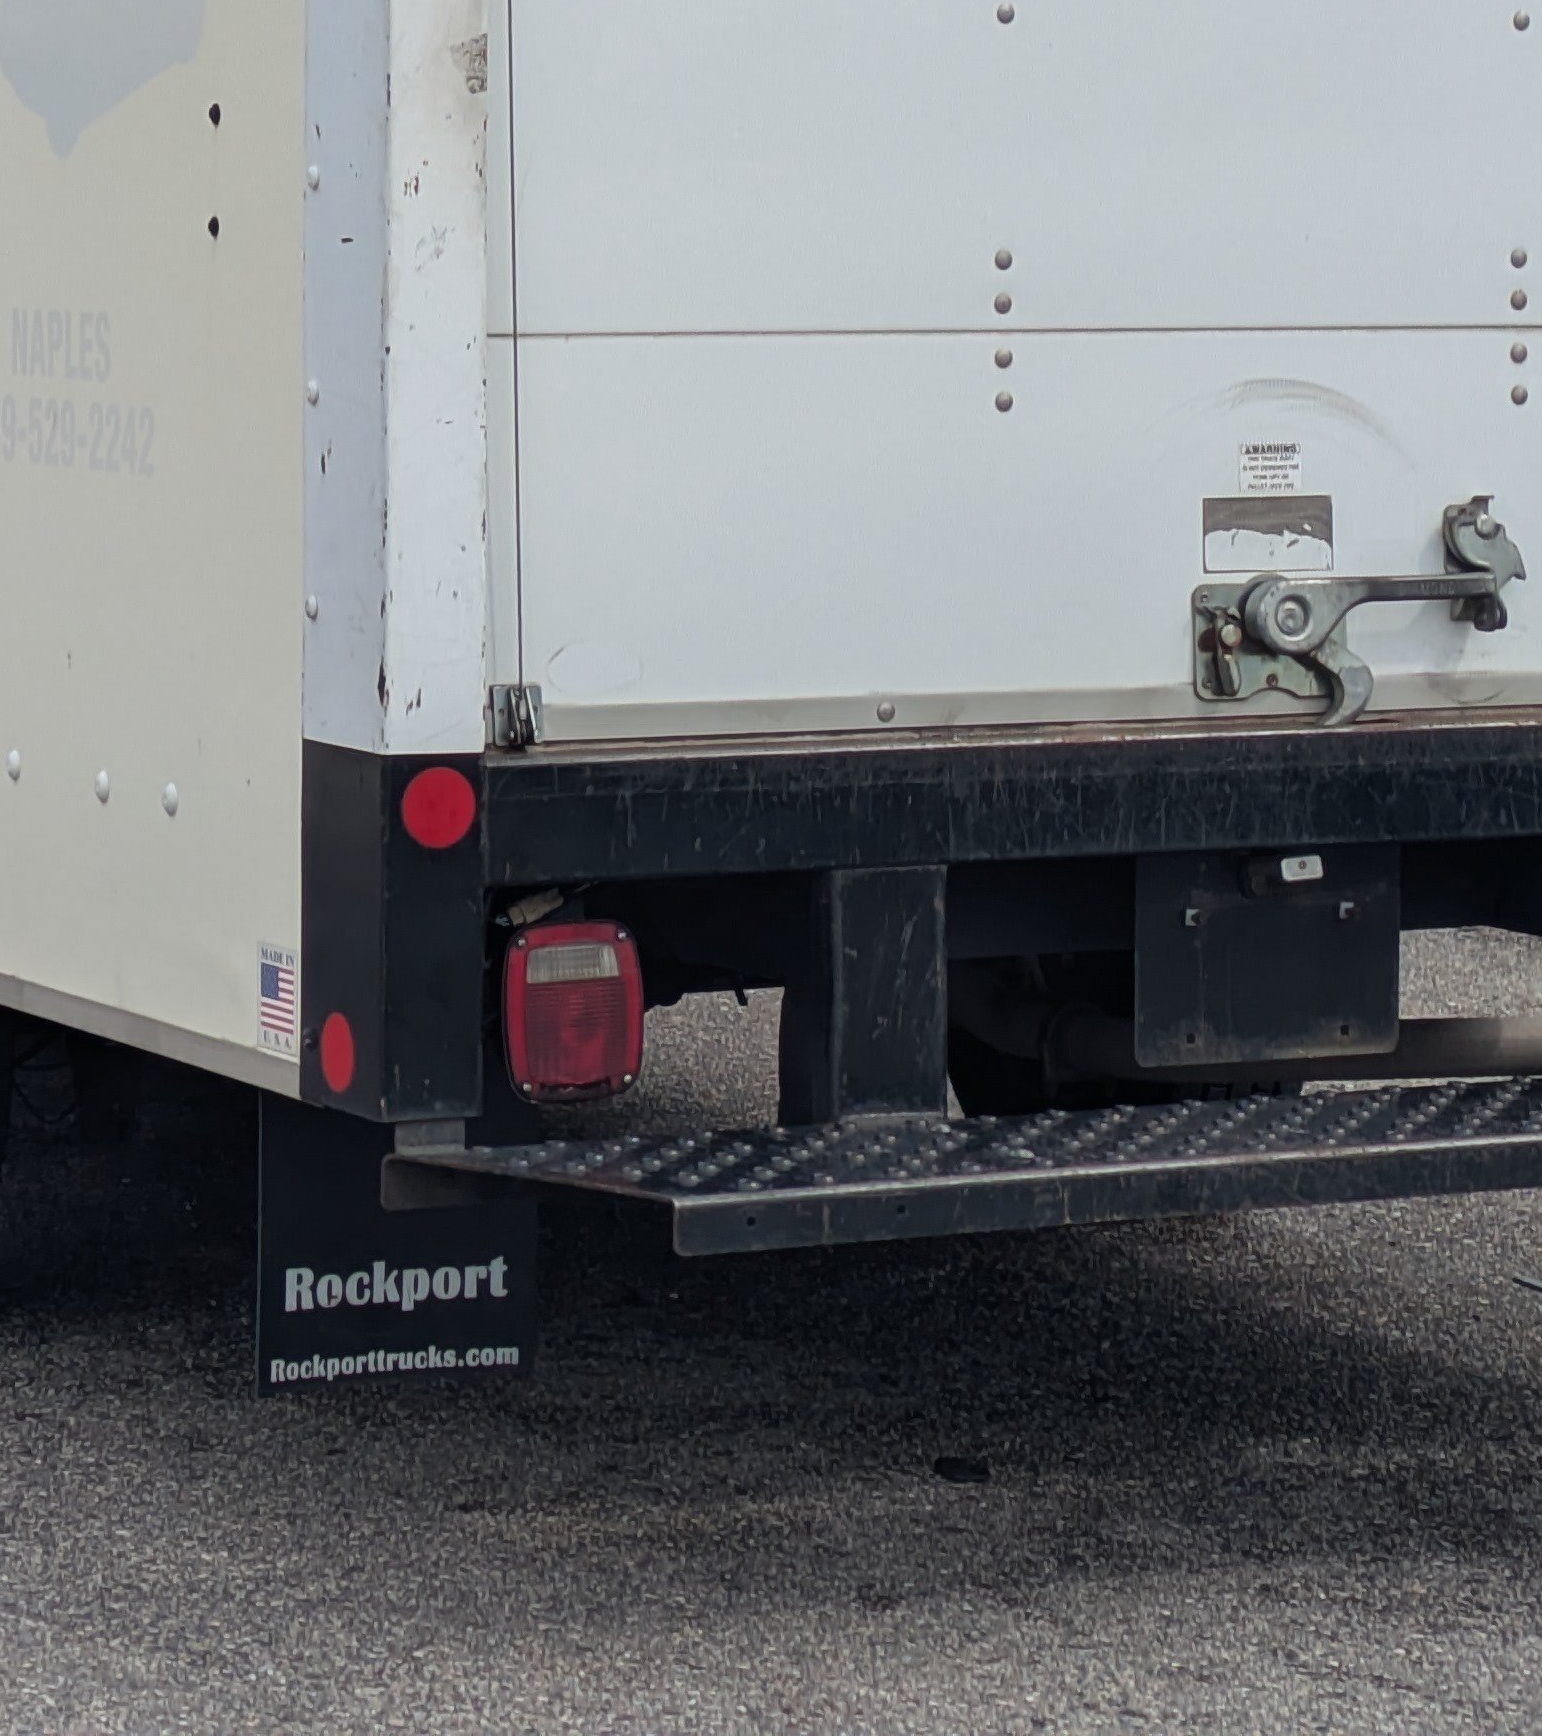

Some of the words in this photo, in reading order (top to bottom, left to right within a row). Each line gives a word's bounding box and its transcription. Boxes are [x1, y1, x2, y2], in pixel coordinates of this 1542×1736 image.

[11, 307, 111, 383] NAPLES
[284, 1255, 509, 1313] Rockport
[270, 1344, 519, 1383] Rockporttrucks.com
